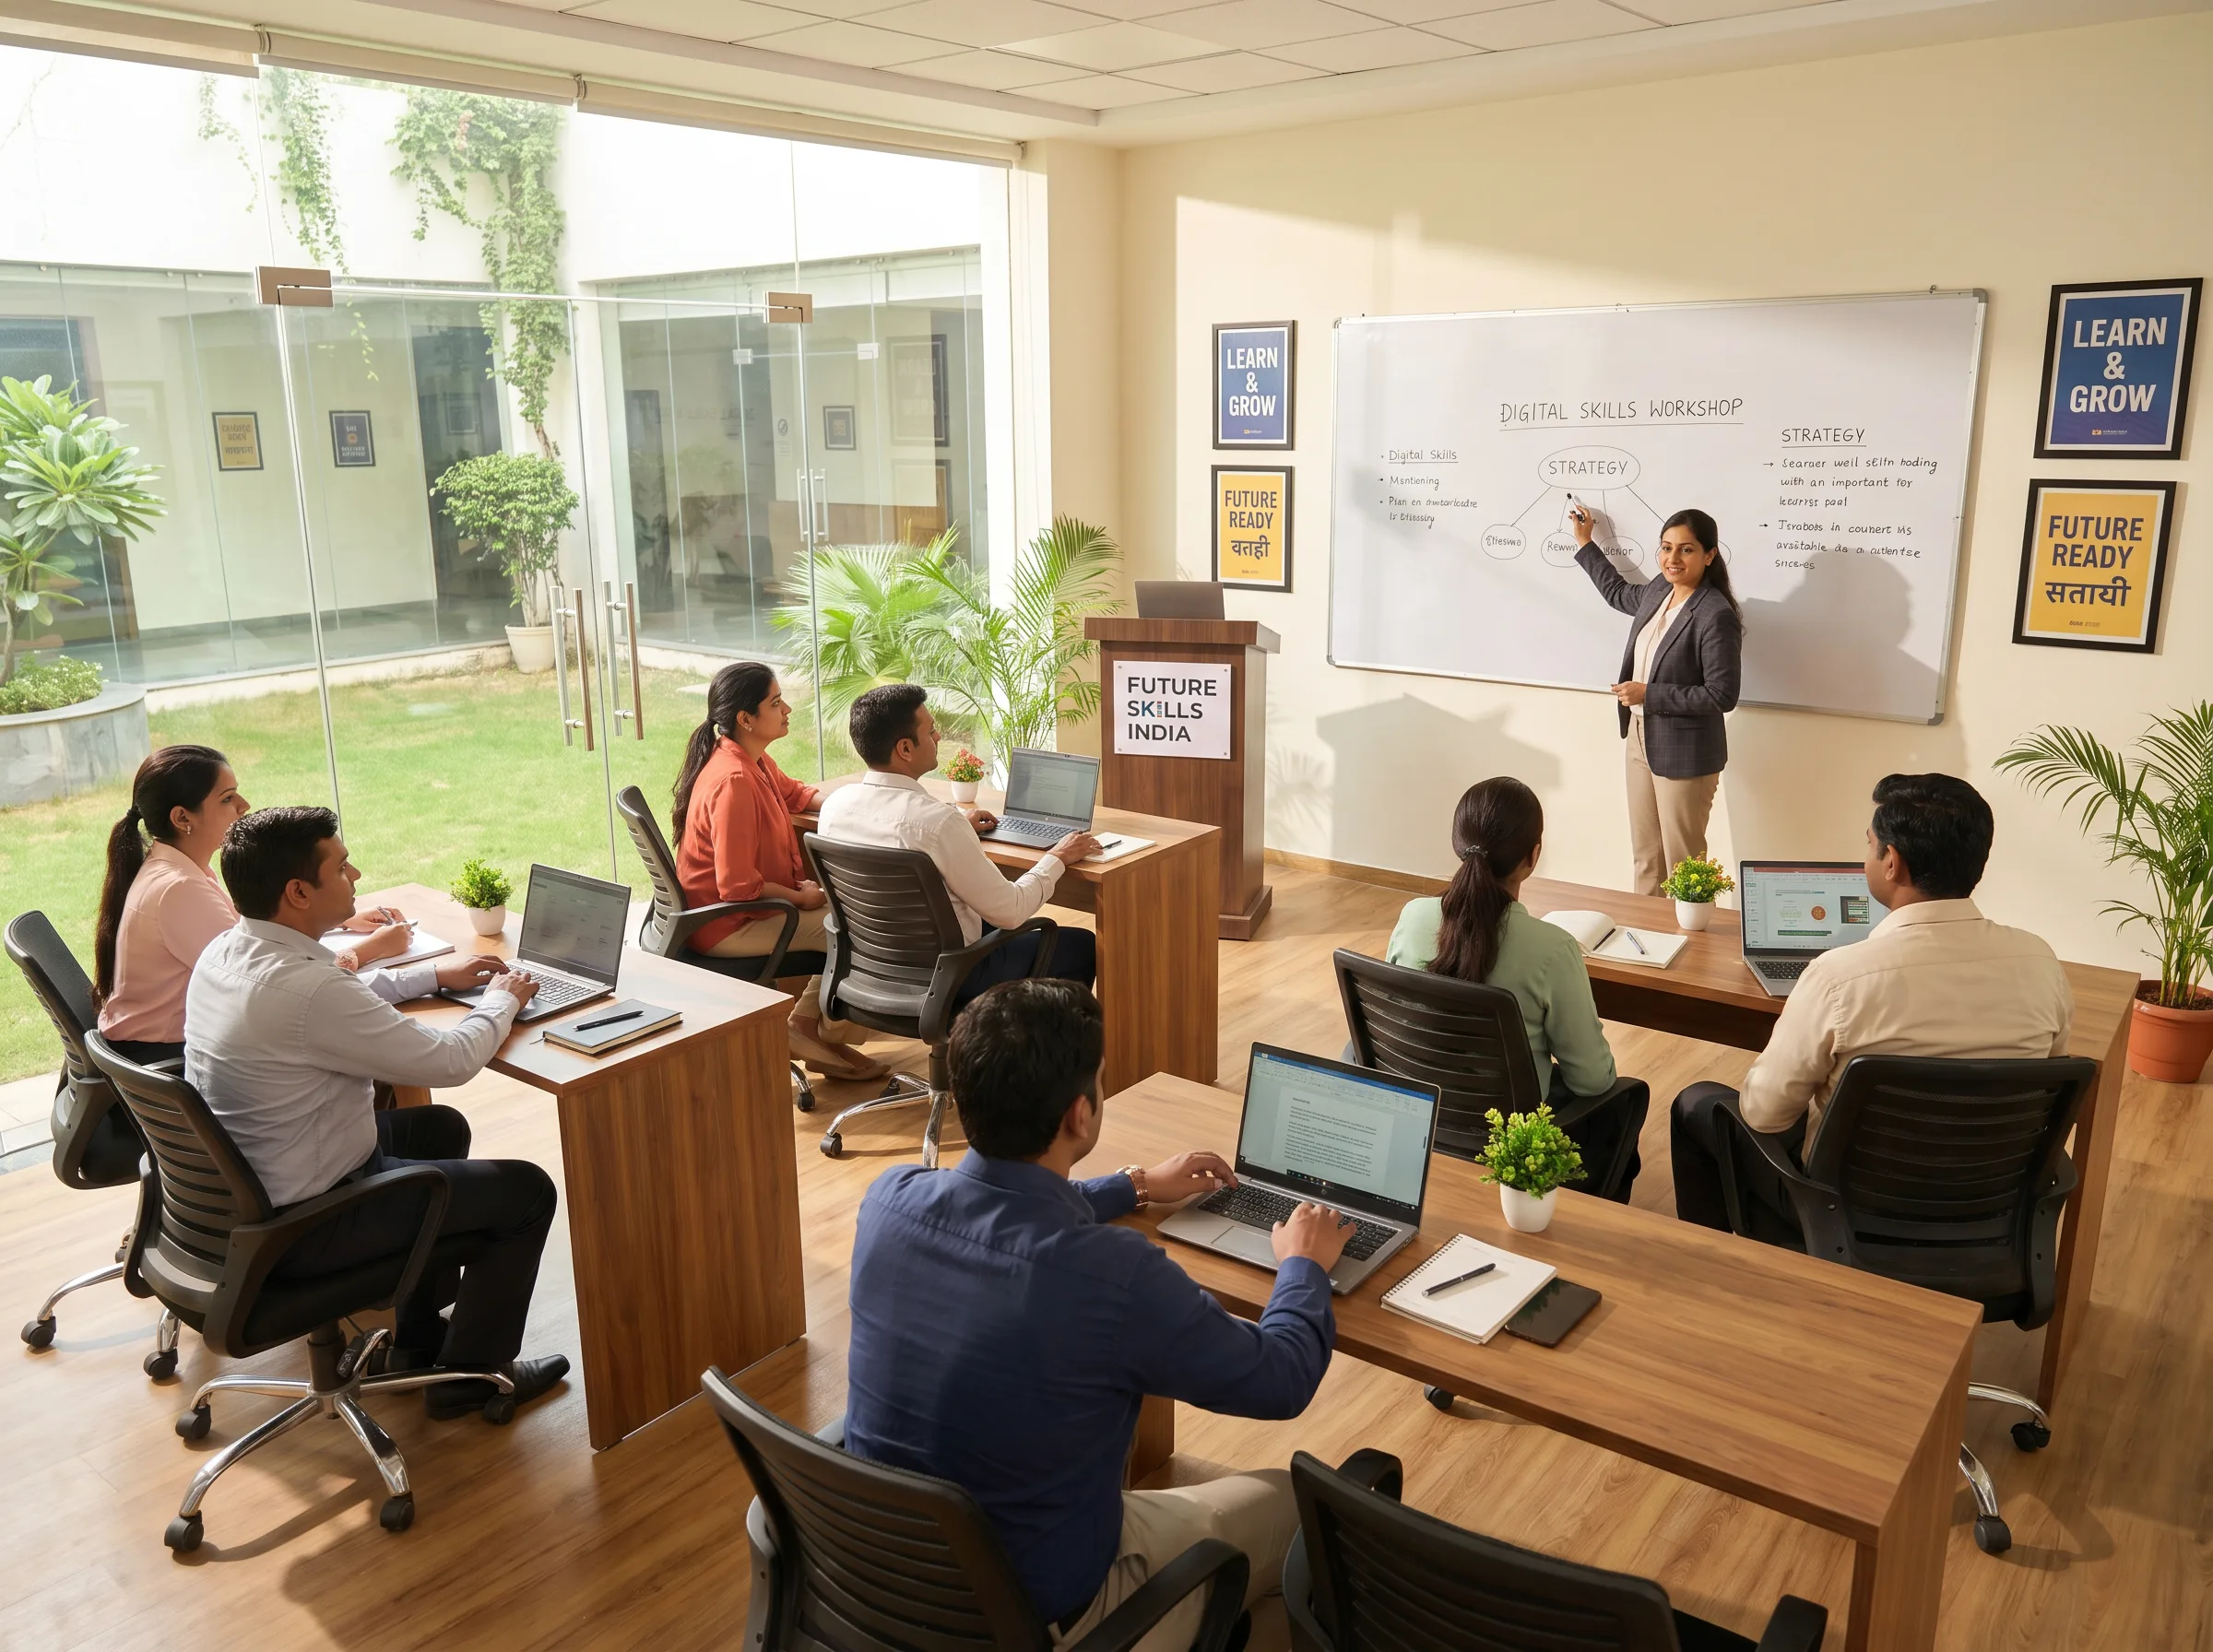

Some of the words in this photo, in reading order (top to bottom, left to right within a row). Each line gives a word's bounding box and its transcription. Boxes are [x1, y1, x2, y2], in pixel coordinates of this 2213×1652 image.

[2073, 316, 2168, 348] LEARN
[1226, 347, 1278, 370] LEARN
[2103, 351, 2125, 380] &
[1246, 372, 1259, 393] &
[1229, 395, 1276, 417] GROW
[2069, 384, 2157, 413] GROW
[1500, 402, 1568, 423] DIGITAL
[1580, 401, 1637, 419] SKILLS
[1650, 397, 1743, 418] WORKSHOP
[1781, 428, 1865, 442] STRATEGY
[1389, 450, 1423, 465] Digital
[1430, 450, 1457, 460] Skills
[1548, 460, 1628, 476] STRATEGY
[1810, 478, 1825, 487] an
[1832, 477, 1889, 490] important
[1225, 490, 1278, 509] FUTURE
[1229, 511, 1274, 529] READY
[2048, 514, 2145, 542] FUTURE
[2052, 543, 2135, 570] READY
[1128, 677, 1217, 696] FUTURE
[1127, 700, 1203, 719] SKILLS
[1128, 724, 1192, 742] INDIA
